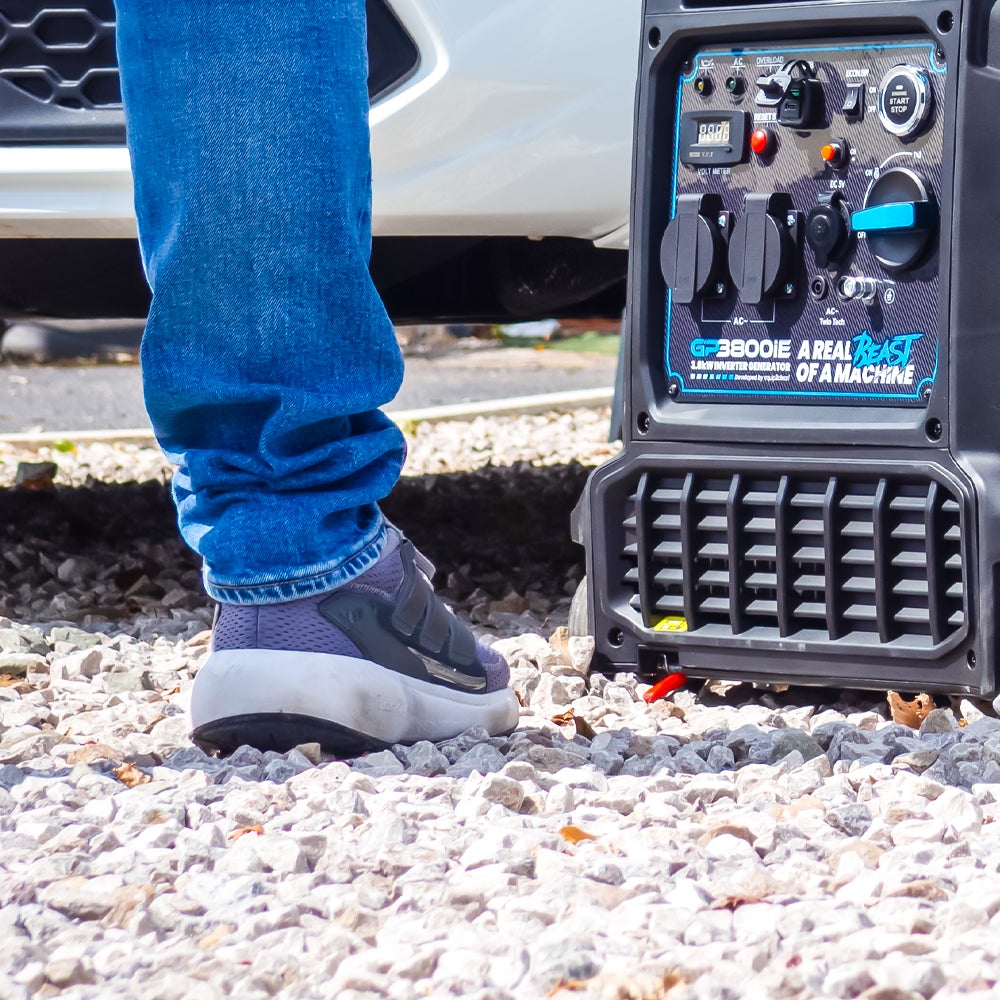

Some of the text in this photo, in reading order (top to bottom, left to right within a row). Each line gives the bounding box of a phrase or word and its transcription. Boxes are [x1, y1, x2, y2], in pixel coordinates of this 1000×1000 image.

[756, 56, 784, 64] OVERLOAD
[889, 97, 910, 105] START
[890, 105, 908, 113] STOP
[697, 167, 731, 175] VOLT METER
[690, 338, 792, 358] GP3800iE
[797, 330, 925, 369] A REAL BEAST
[713, 361, 748, 371] INVERTER
[748, 362, 791, 372] GENERATOR
[796, 362, 915, 385] OF A MACHINE
